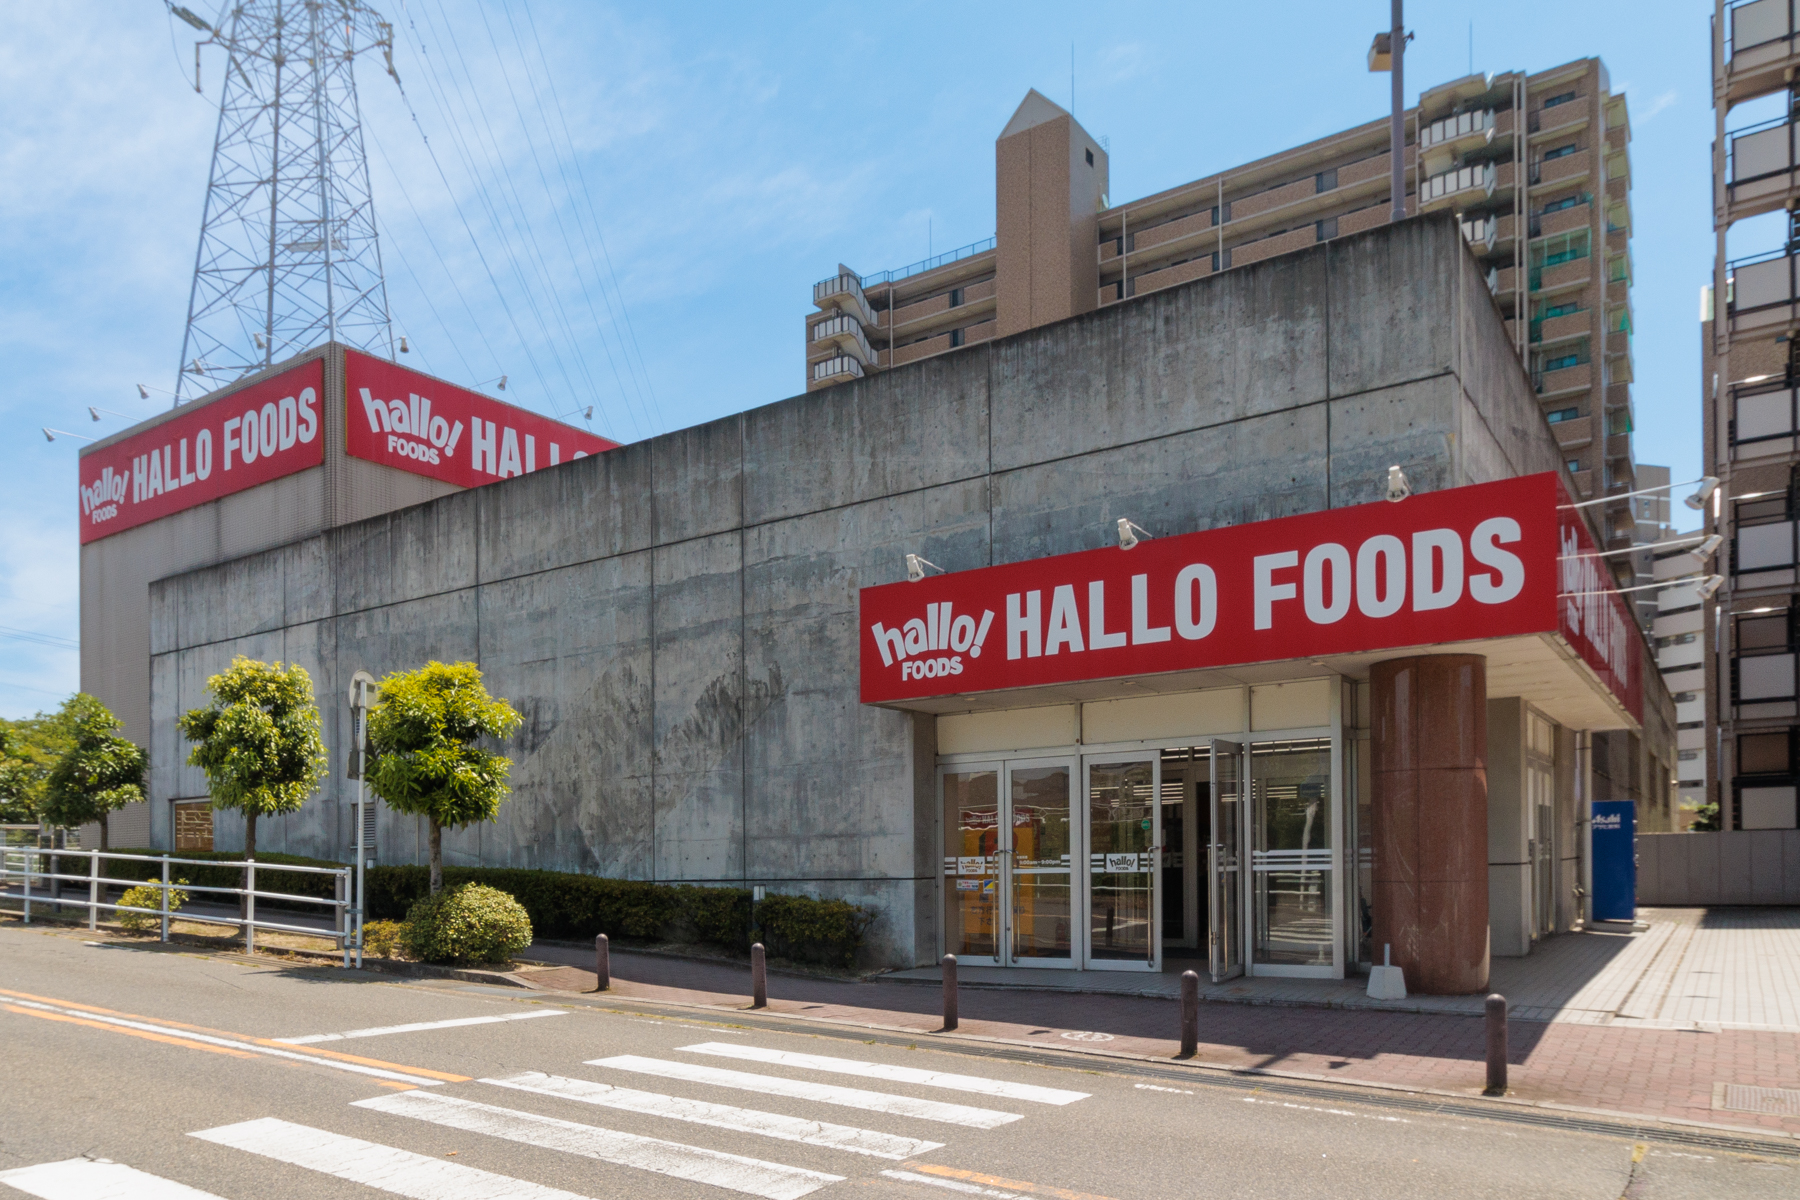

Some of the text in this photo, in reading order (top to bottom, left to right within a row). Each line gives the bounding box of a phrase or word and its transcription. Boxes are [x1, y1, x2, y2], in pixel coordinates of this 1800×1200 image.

[133, 387, 318, 504] HALLO FOODS
[359, 387, 464, 457] hallo!
[388, 435, 440, 466] FOODS
[81, 467, 130, 516] hallo!
[92, 504, 118, 524] FOODS
[1007, 517, 1526, 660] HALLO FOODS
[872, 602, 994, 667] hallo!
[902, 656, 964, 682] FOODS
[1109, 856, 1135, 867] hallo!
